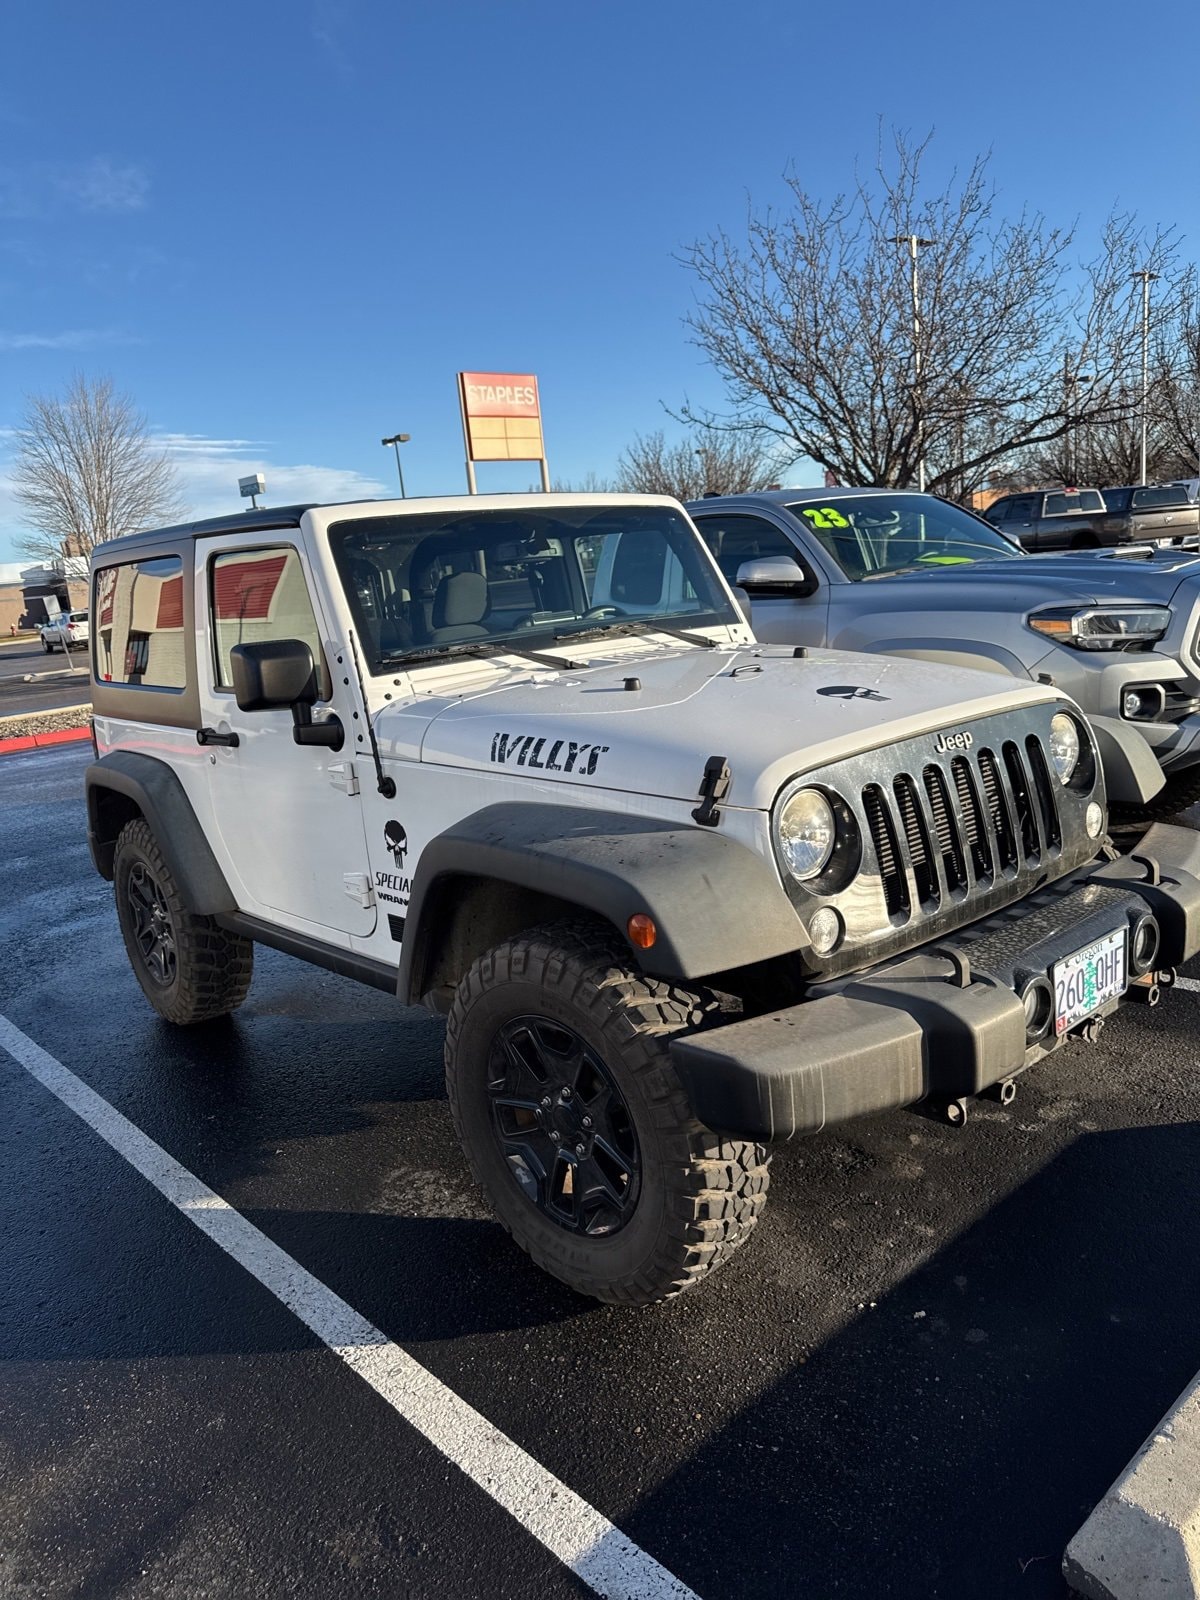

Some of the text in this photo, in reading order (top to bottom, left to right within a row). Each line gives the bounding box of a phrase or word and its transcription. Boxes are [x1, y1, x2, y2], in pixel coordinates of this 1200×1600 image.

[467, 385, 535, 405] STAPLES
[802, 507, 849, 529] 23
[490, 732, 610, 776] WILLYS
[934, 731, 973, 754] Jeep
[1056, 968, 1085, 1017] 260
